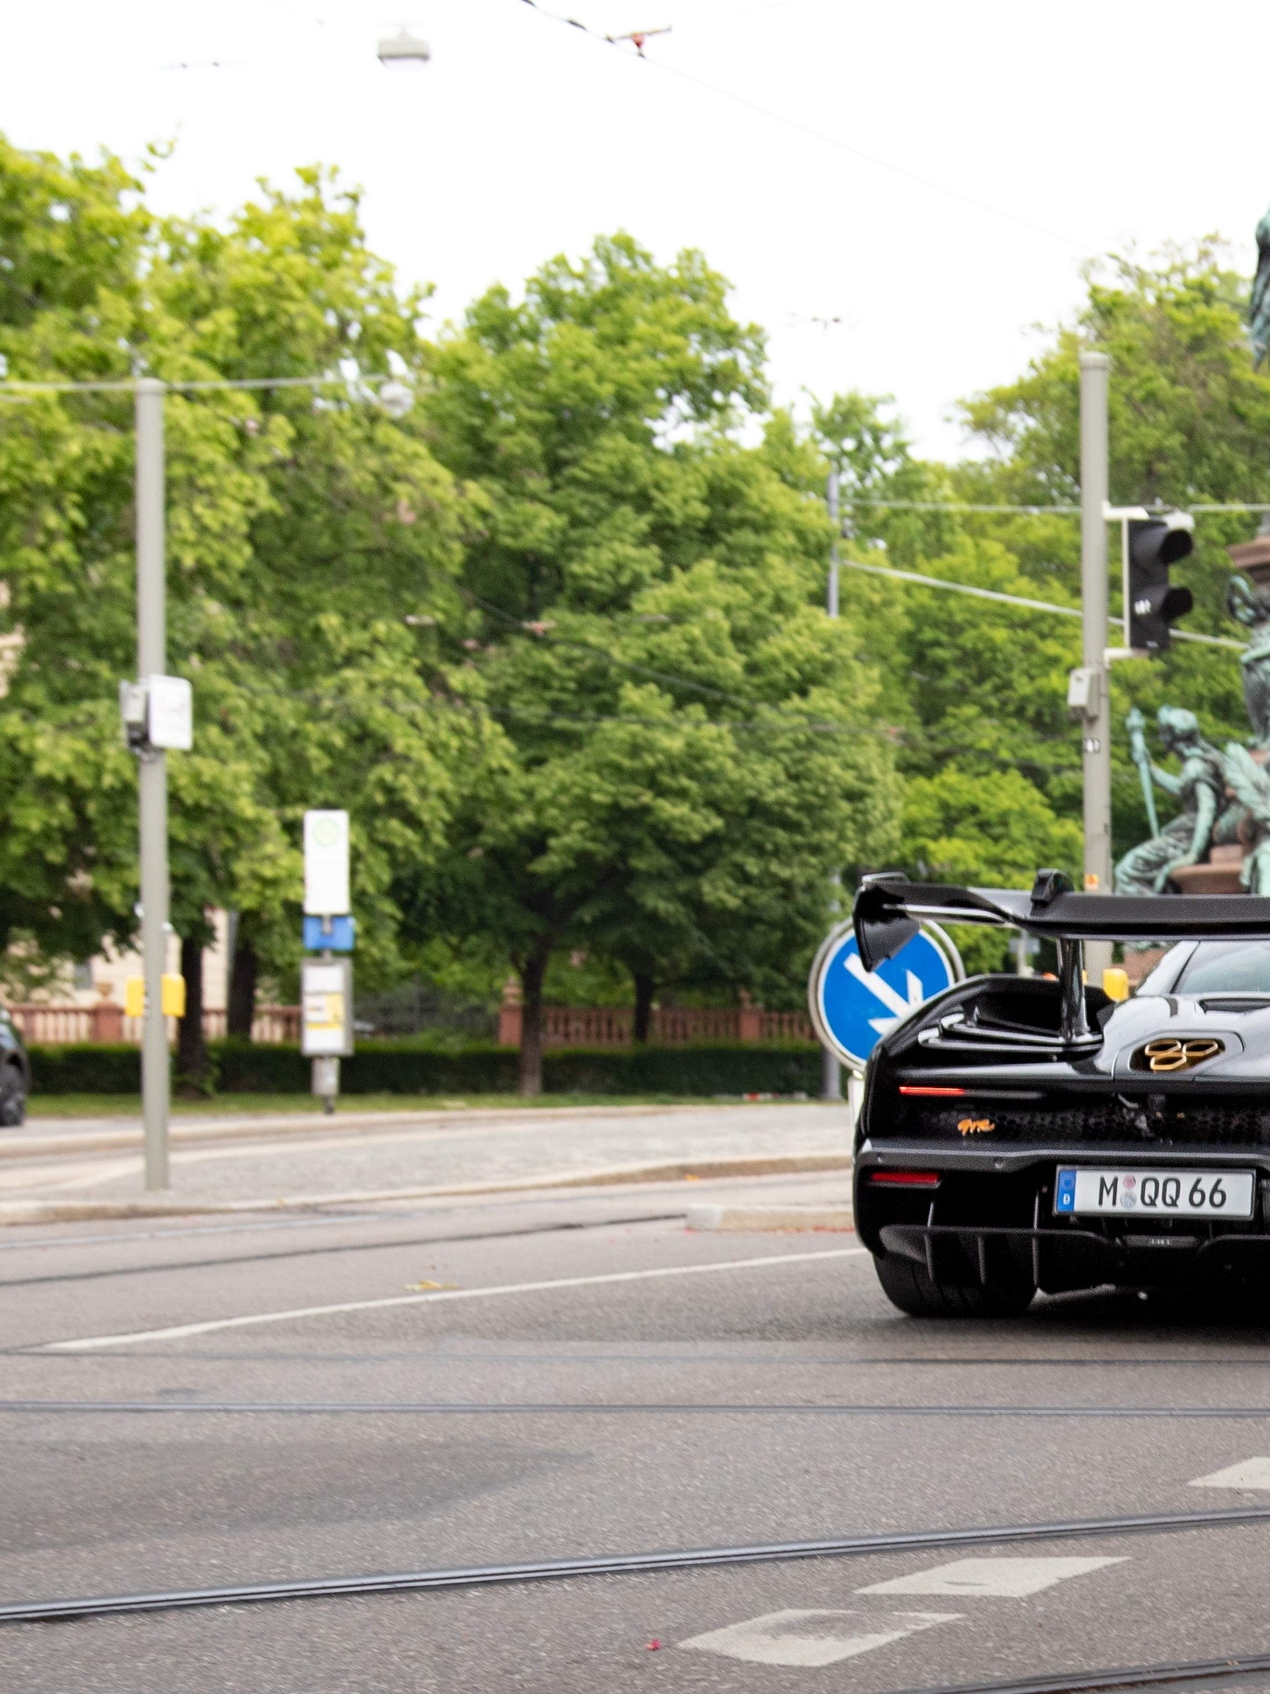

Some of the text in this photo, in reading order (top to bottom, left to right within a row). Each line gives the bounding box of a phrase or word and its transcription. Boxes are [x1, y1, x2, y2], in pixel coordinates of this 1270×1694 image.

[1098, 1176, 1227, 1208] M QQ 66
